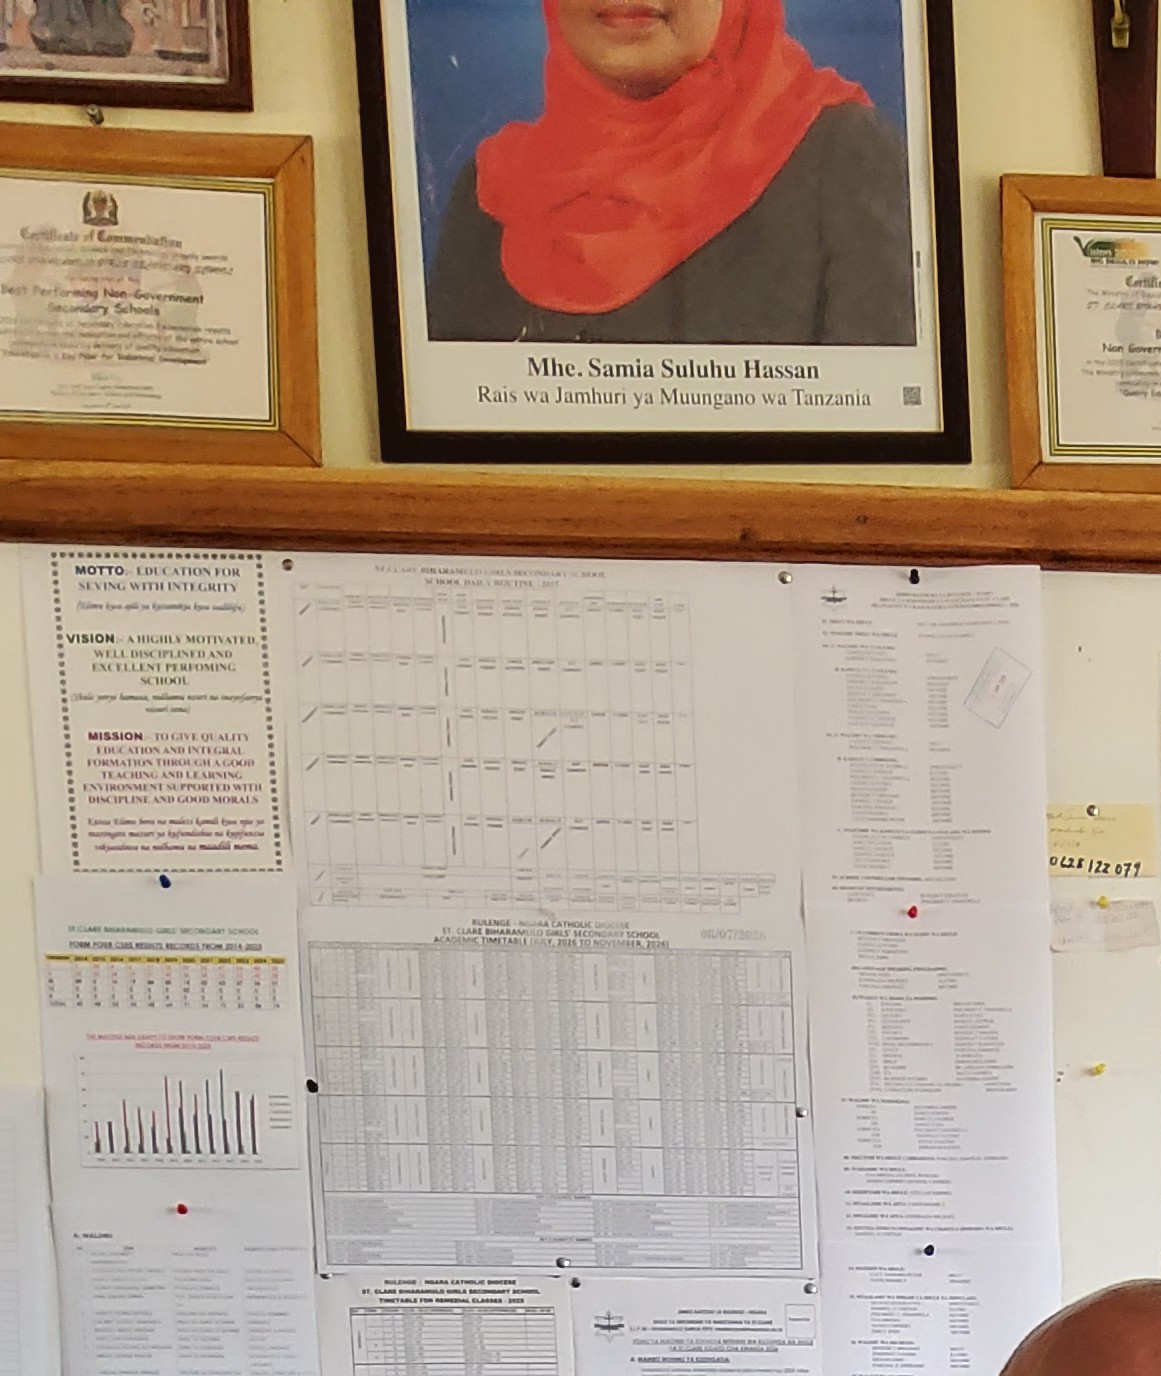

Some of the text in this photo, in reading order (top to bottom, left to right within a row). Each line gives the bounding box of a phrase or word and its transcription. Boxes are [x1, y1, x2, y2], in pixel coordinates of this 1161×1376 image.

[114, 303, 160, 316] Schools
[1102, 343, 1123, 353] Non
[527, 357, 819, 380] Mhe. Samia Suluhu Hassan
[478, 385, 871, 410] Rais wa Jamhuri ya Muungano wa Tanzania
[137, 567, 211, 577] EDUCATION
[215, 567, 240, 577] FOR
[78, 581, 237, 592] SEVING WITH INTEGRITY
[127, 635, 135, 644] A
[138, 635, 181, 644] HIGHLY
[94, 650, 232, 659] WELL DISCIPLINED AND
[92, 663, 236, 672] EXCELLENT PERFOMING
[140, 677, 189, 685] SCHOOL
[155, 733, 168, 741] TO
[171, 733, 196, 741] GIVE
[201, 733, 249, 743] QUALITY
[97, 746, 244, 755] EDUCATION AND INTEGRAL
[87, 759, 153, 767] FORMATION
[157, 759, 210, 767] THROUGH
[223, 759, 254, 767] GOOD
[102, 771, 242, 779] TEACHING AND LEARNING
[83, 784, 262, 792] ENVIRONMENT SUPPORTED WITH
[88, 796, 258, 804] DISCIPLINE AND GOOD MORALS
[1088, 859, 1110, 873] 122
